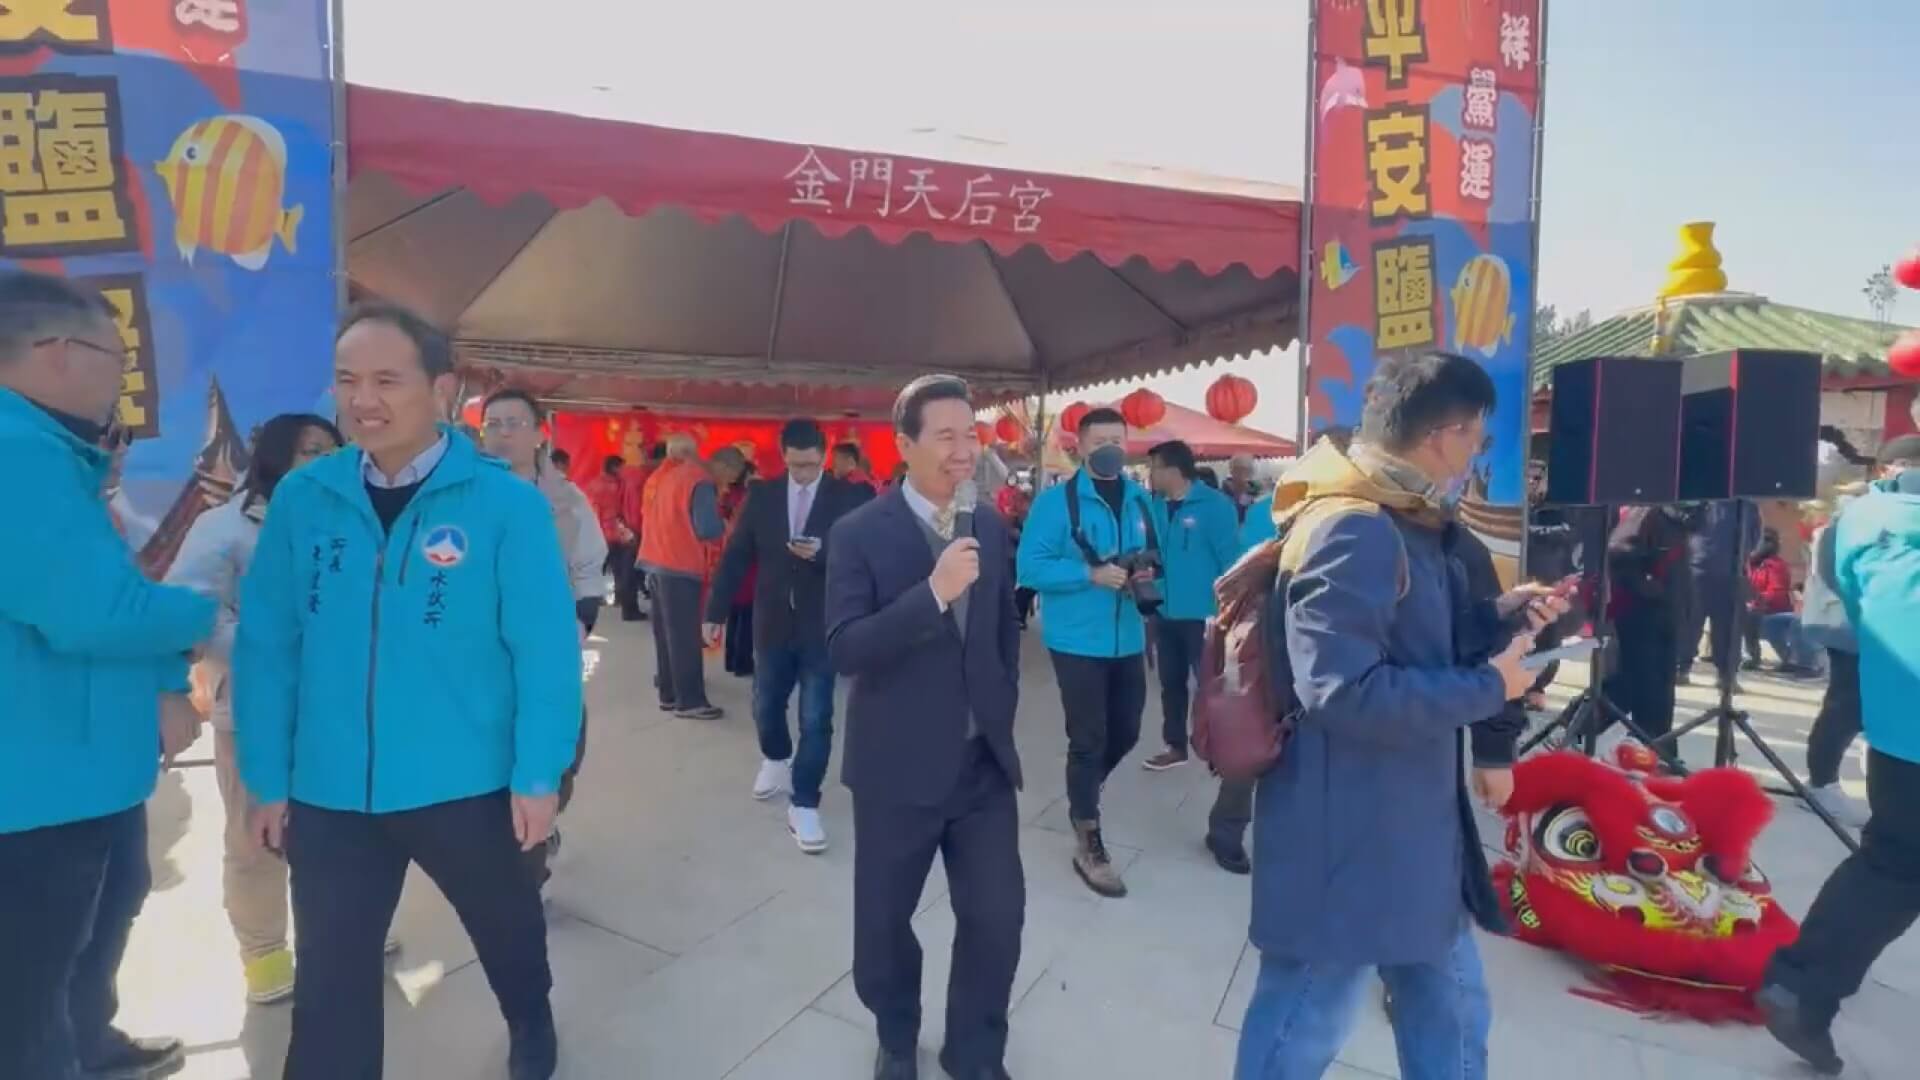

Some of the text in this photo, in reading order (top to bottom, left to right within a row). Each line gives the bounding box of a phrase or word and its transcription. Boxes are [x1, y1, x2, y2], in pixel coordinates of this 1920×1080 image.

[784, 146, 1054, 233] 金門天后宮
